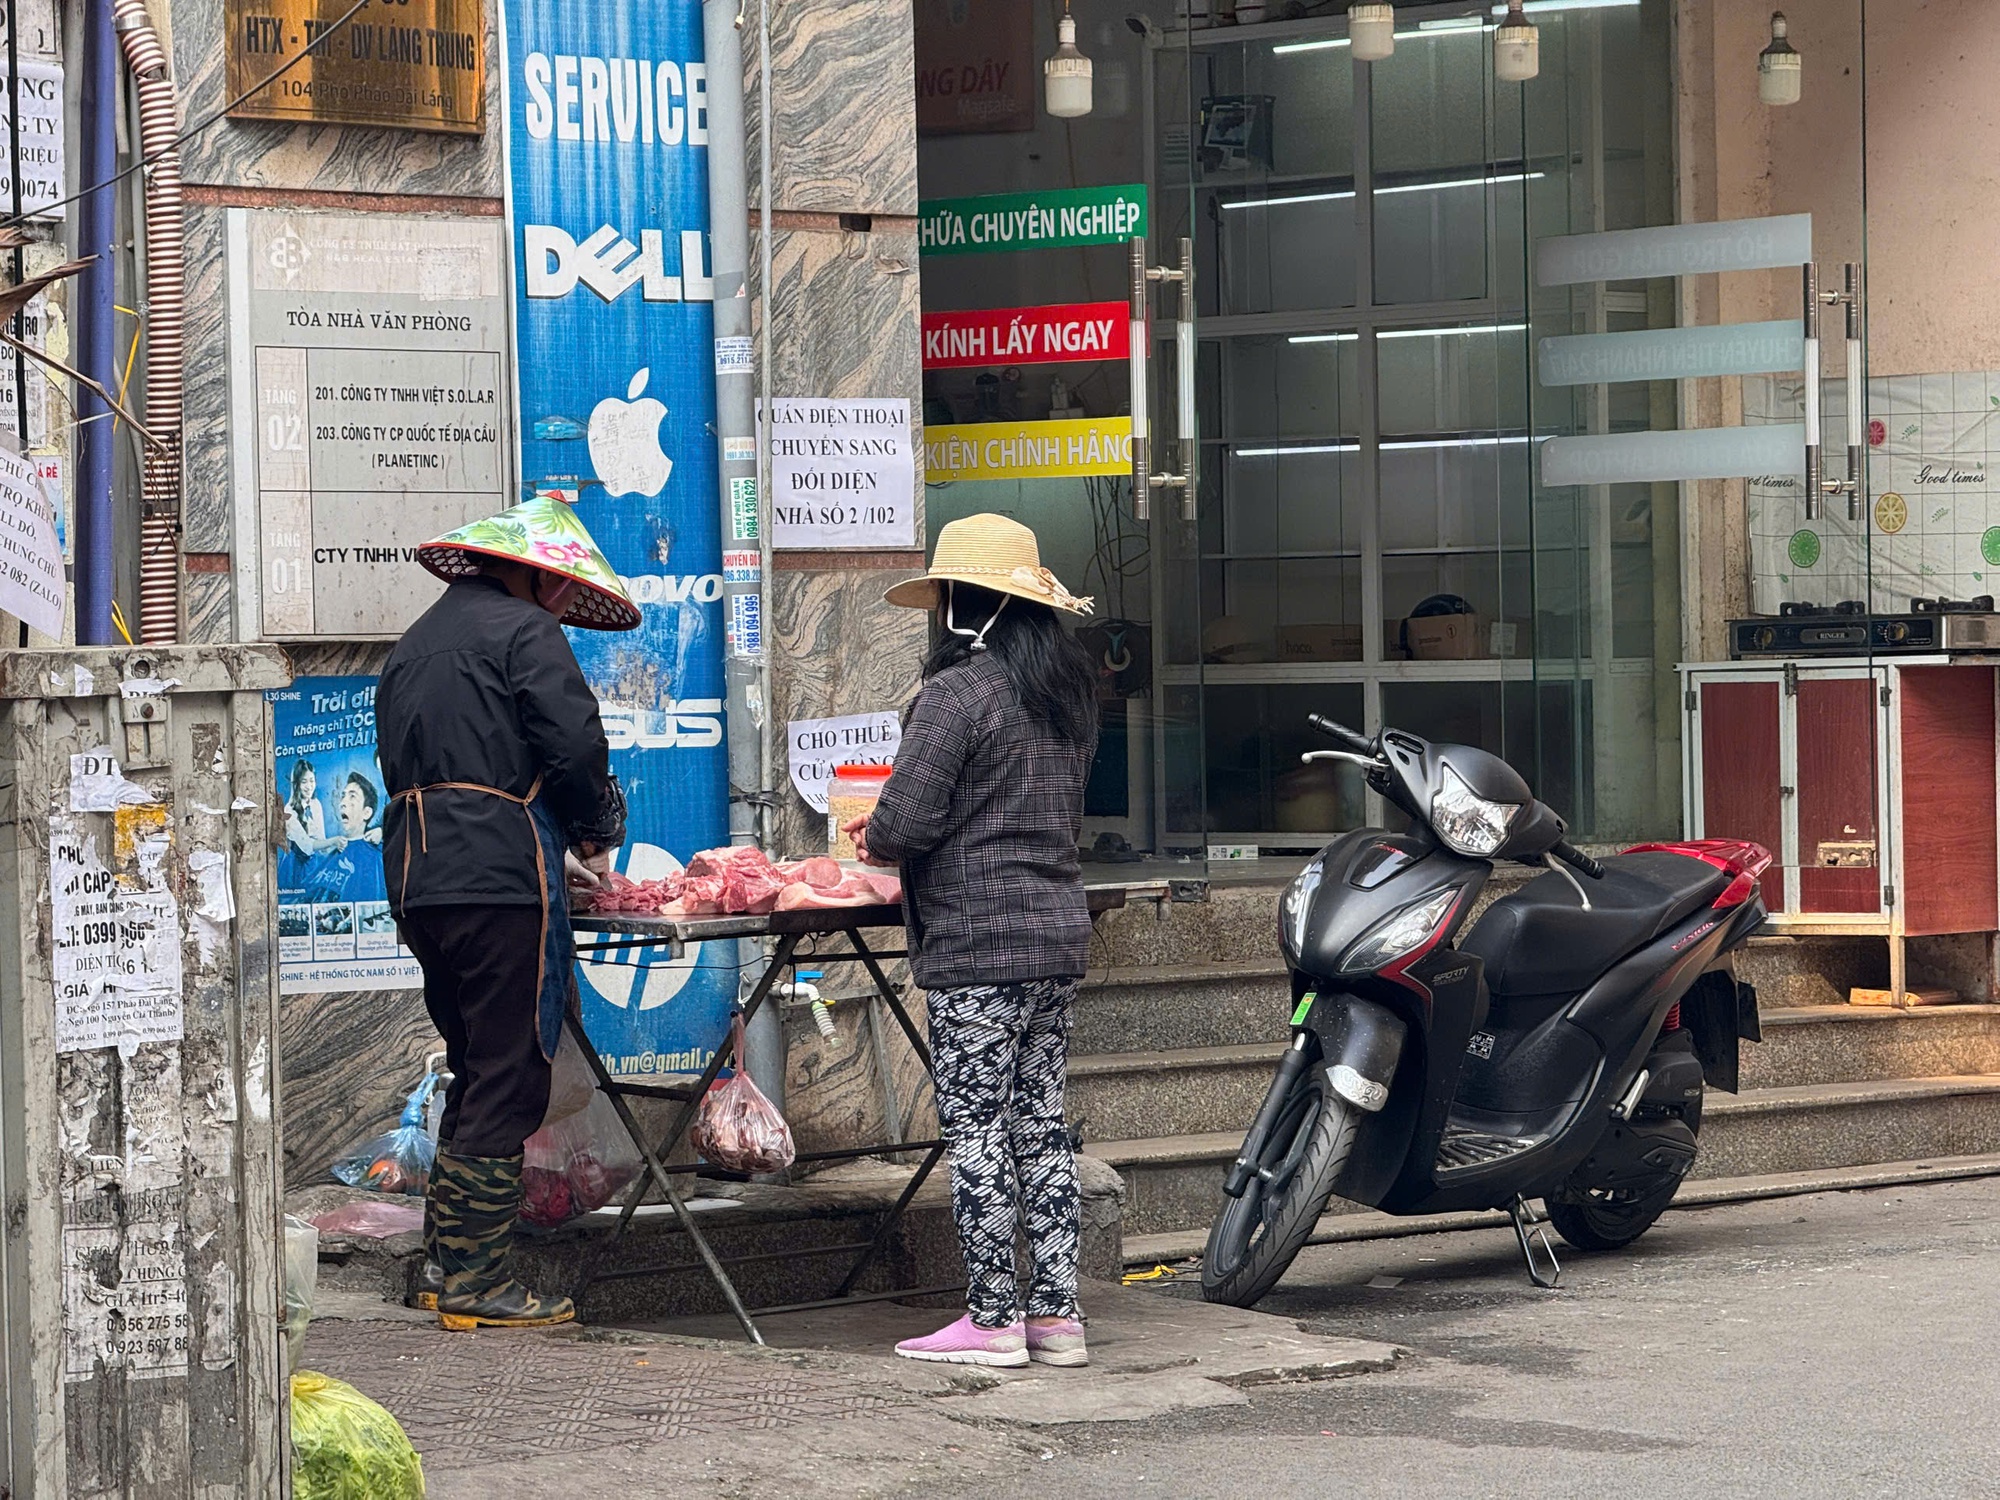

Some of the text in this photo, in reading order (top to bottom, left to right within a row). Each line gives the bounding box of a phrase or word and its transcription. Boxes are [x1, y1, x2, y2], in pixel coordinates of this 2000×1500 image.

[246, 16, 284, 54] HTX
[378, 18, 422, 65] LÁNG
[426, 28, 475, 71] TRUNG
[282, 80, 312, 97] 104
[524, 52, 708, 146] SERVICE
[33, 117, 58, 135] TY
[970, 203, 1055, 242] CHUYÊN
[1060, 197, 1140, 243] NGHIỆP
[524, 223, 713, 303] DELL
[287, 306, 472, 332] TÒA NHÀ VĂN PHÒNG
[926, 315, 1114, 359] KÍNH LẤY NGAY
[341, 384, 371, 402] CÔNG
[374, 387, 388, 402] TY
[391, 388, 419, 403] TNHH
[422, 386, 445, 406] VIỆT
[758, 404, 904, 428] UÁN ĐIỆN THOẠI
[267, 413, 303, 451] 02
[341, 423, 371, 441] CÔNG
[373, 427, 387, 441] TY
[390, 427, 404, 441] CP
[406, 422, 436, 442] QUỐC
[439, 423, 451, 442] TẾ
[453, 428, 472, 445] ĐỊA
[474, 423, 496, 443] CẦU
[771, 434, 844, 456] CHUYỂN
[849, 438, 897, 456] SANG
[926, 435, 978, 478] KIỆN
[984, 432, 1060, 468] CHÍNH
[791, 467, 878, 495] ĐỐI DIỆN
[1913, 464, 1986, 485] Good times
[774, 502, 815, 525] NHÀ
[820, 502, 844, 525] SỐ
[314, 548, 418, 564] CTY TNHH VI
[281, 691, 301, 701] SHINE
[312, 686, 377, 714] Trời ơi!
[293, 710, 376, 737] Không chỉ TÓC
[797, 720, 892, 750] CHO THUÊ
[275, 728, 370, 757] Còn quá trời TRẢI
[83, 757, 114, 776] ĐT
[798, 758, 837, 781] CỬA
[84, 922, 116, 945] 0399
[76, 954, 103, 973] DIỆN
[281, 972, 304, 982] SHINE
[310, 971, 320, 982] HỆ
[321, 967, 349, 980] THỐNG
[350, 966, 366, 978] TÓC
[367, 966, 384, 977] NAM
[386, 966, 397, 976] SỐ
[404, 966, 420, 978] VIỆT
[64, 980, 89, 998] GIÁ
[127, 1267, 175, 1280] CHUNG
[147, 1315, 171, 1330] 275
[147, 1338, 171, 1353] 597
